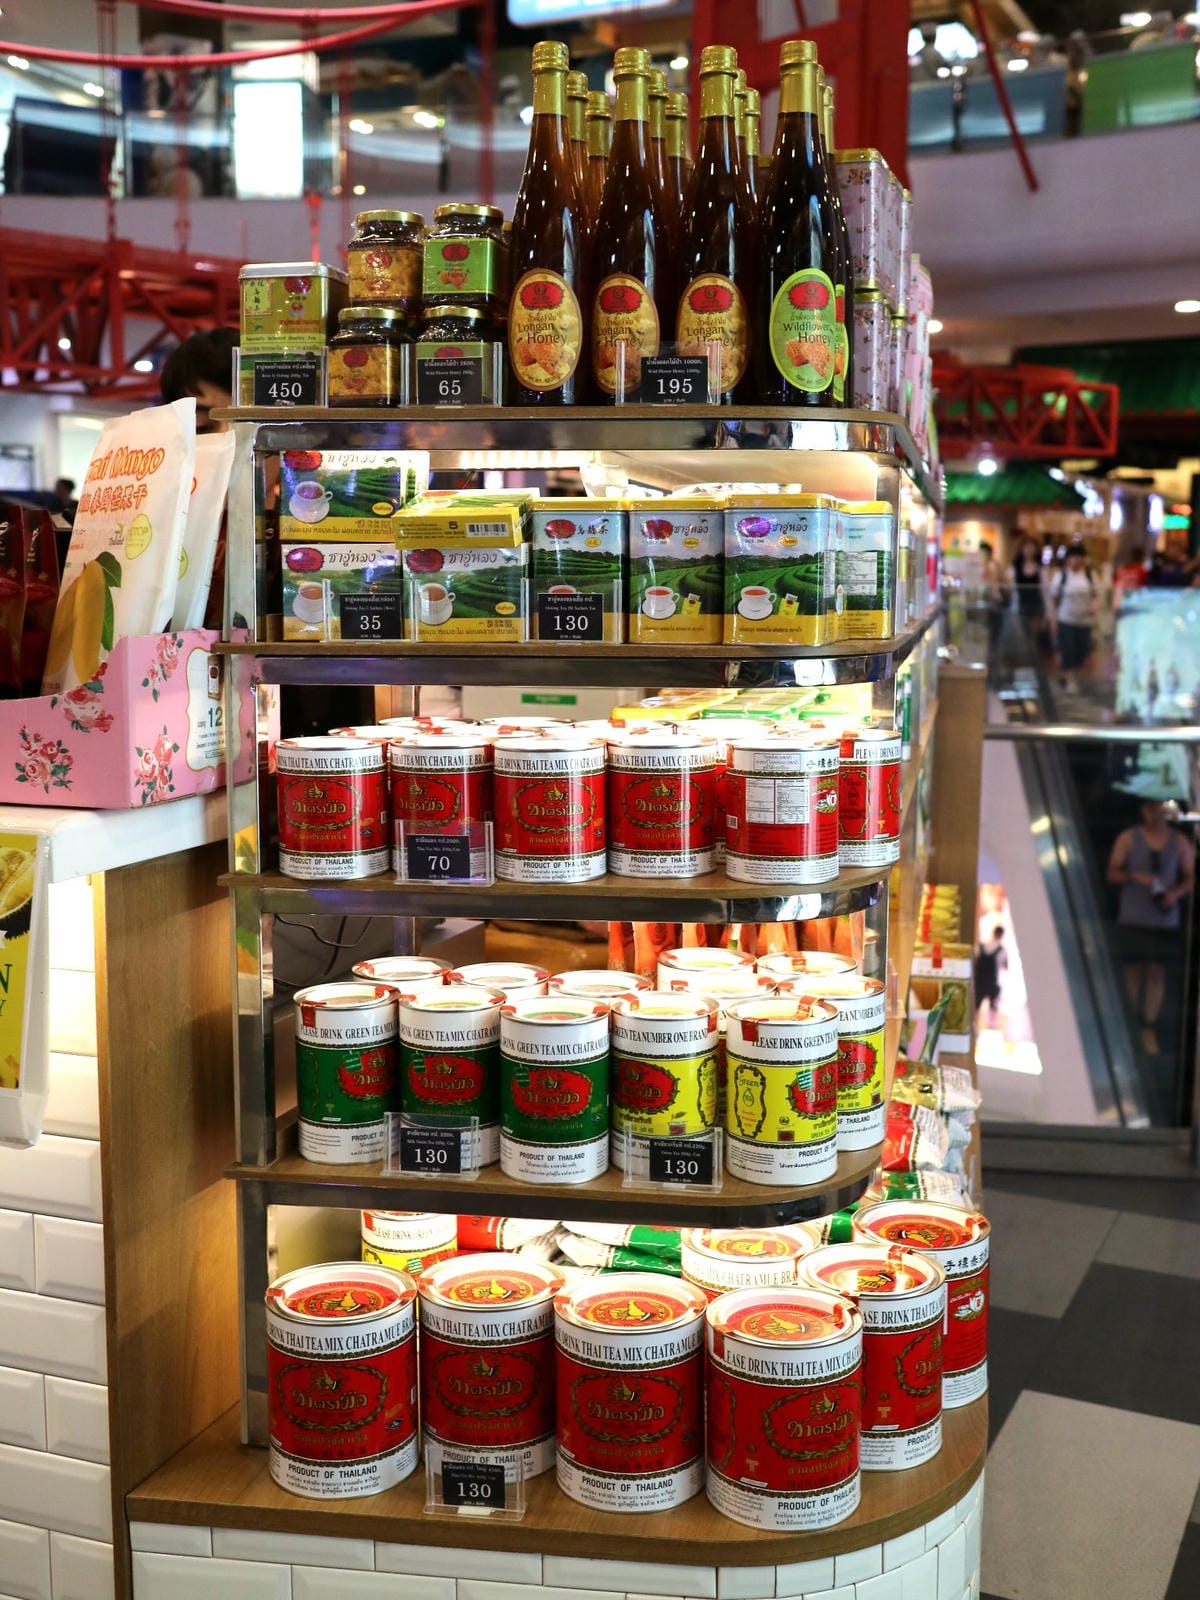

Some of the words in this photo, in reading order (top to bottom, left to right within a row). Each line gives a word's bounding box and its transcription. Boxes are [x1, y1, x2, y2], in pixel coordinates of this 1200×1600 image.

[519, 322, 554, 334] Longan
[597, 326, 630, 338] Longan
[687, 326, 724, 338] Longan
[527, 332, 568, 346] Honey
[268, 382, 302, 398] 450
[438, 379, 461, 396] 65
[656, 378, 693, 395] 195
[328, 549, 377, 567] ชาอู่หลอง
[448, 550, 498, 568] ชาอู่หลอง
[360, 615, 382, 630] 35
[553, 615, 589, 631] 130
[301, 757, 314, 769] TEA
[315, 758, 329, 769] MIX
[414, 755, 427, 767] MIX
[522, 759, 539, 771] THAI
[540, 759, 554, 771] TEA
[554, 759, 569, 771] MIX
[631, 755, 647, 767] THAI
[647, 756, 660, 767] TEA
[662, 755, 676, 767] MIX
[289, 856, 311, 866] PRODUCT
[314, 857, 322, 866] OF
[325, 857, 354, 866] THAILAND
[428, 855, 450, 871] 70
[523, 861, 550, 869] PRODUCT
[553, 861, 561, 869] OF
[630, 855, 658, 864] PRODUCT
[659, 855, 668, 864] OF
[839, 1010, 849, 1022] EA
[320, 1028, 343, 1040] DRINK
[345, 1026, 370, 1040] GREEN
[371, 1024, 384, 1037] TEA
[413, 1028, 434, 1041] GREEN
[435, 1030, 450, 1042] TEA
[450, 1030, 465, 1042] MIX
[629, 1029, 641, 1041] TEA
[641, 1031, 673, 1044] NUMBER
[673, 1031, 689, 1043] ONE
[517, 1041, 540, 1055] GREEN
[541, 1044, 556, 1056] TEA
[556, 1044, 571, 1056] MIX
[780, 1038, 803, 1049] DRINK
[803, 1035, 825, 1049] GREEN
[739, 1076, 759, 1087] Green
[846, 1115, 871, 1125] THAILAND
[351, 1132, 378, 1142] PRODUCT
[414, 1148, 448, 1164] 130
[519, 1151, 546, 1162] PRODUCT
[547, 1153, 555, 1162] OF
[558, 1152, 585, 1162] THAILAND
[798, 1148, 823, 1158] PRODUCT
[664, 1159, 699, 1175] 130
[881, 1308, 910, 1325] DRINK
[911, 1304, 928, 1321] THAI
[442, 1319, 461, 1336] THAI
[463, 1322, 480, 1338] TEA
[481, 1323, 500, 1338] MIX
[285, 1331, 304, 1349] THAI
[305, 1336, 324, 1351] TEA
[325, 1337, 344, 1351] MIX
[346, 1322, 401, 1351] CHATRAMUE
[562, 1330, 580, 1353] DRINK
[581, 1340, 602, 1359] THAI
[603, 1345, 621, 1361] TEA
[623, 1346, 643, 1361] MIX
[644, 1332, 697, 1361] CHATRAMUE
[724, 1350, 746, 1370] EASE
[748, 1357, 778, 1376] DRINK
[780, 1361, 804, 1377] THAI
[805, 1360, 824, 1376] TEA
[824, 1355, 841, 1373] MIX
[907, 1430, 933, 1447] PRODUCT
[442, 1450, 475, 1463] PRODUCT
[479, 1456, 490, 1464] OF
[288, 1463, 320, 1479] PRODUCT
[324, 1468, 335, 1479] OF
[339, 1464, 378, 1479] THAILAND
[456, 1482, 492, 1498] 130
[581, 1475, 616, 1492] PRODUCT
[620, 1481, 631, 1492] OF
[636, 1477, 674, 1492] THAILAND
[777, 1500, 816, 1511] PRODUCT
[820, 1497, 831, 1508] OF
[833, 1482, 857, 1505] THAILAND
